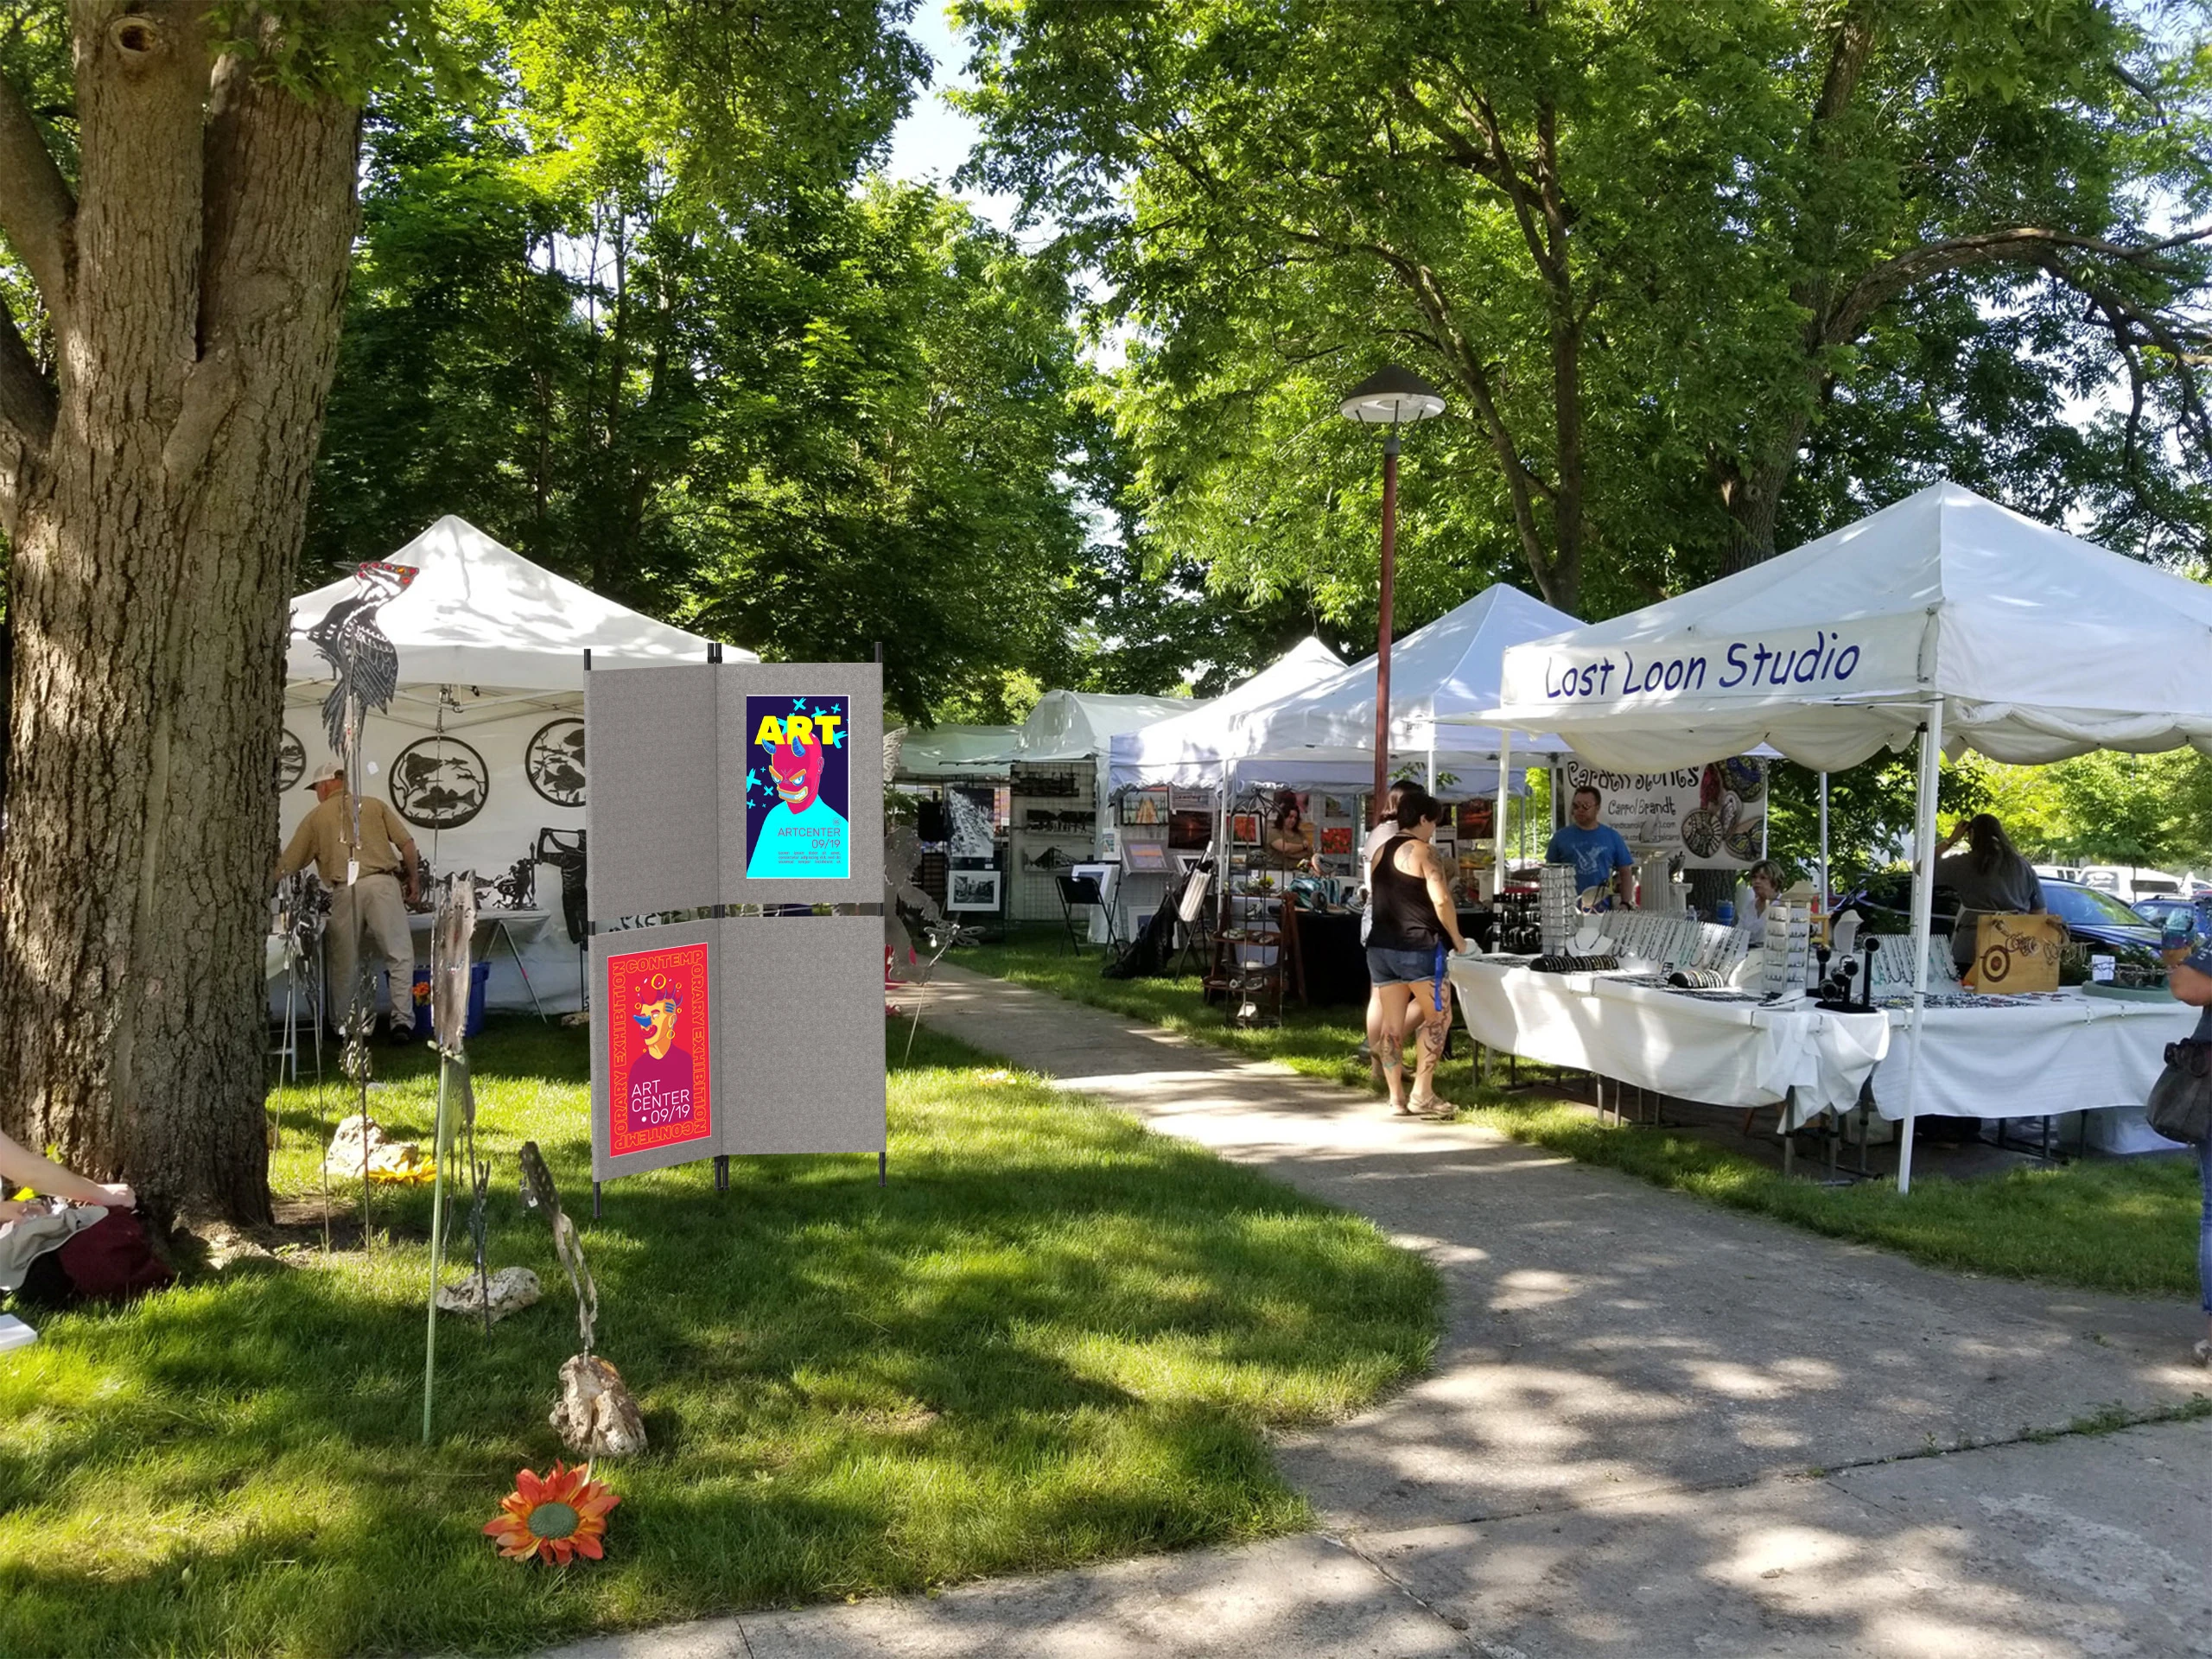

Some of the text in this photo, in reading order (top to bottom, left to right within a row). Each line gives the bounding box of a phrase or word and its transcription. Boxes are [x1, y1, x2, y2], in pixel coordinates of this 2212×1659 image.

[1545, 630, 1860, 699] Lost Loon Studio
[754, 715, 841, 745] ART
[1638, 796, 1676, 816] Brandt
[778, 827, 841, 837] ARTCENTER
[811, 838, 841, 849] 09/19
[612, 961, 627, 1068] EXHIBITION
[632, 1079, 661, 1098] ART
[692, 1027, 707, 1135] EXHIBITION
[632, 1089, 690, 1113] CENTER
[651, 1103, 690, 1124] 09/19
